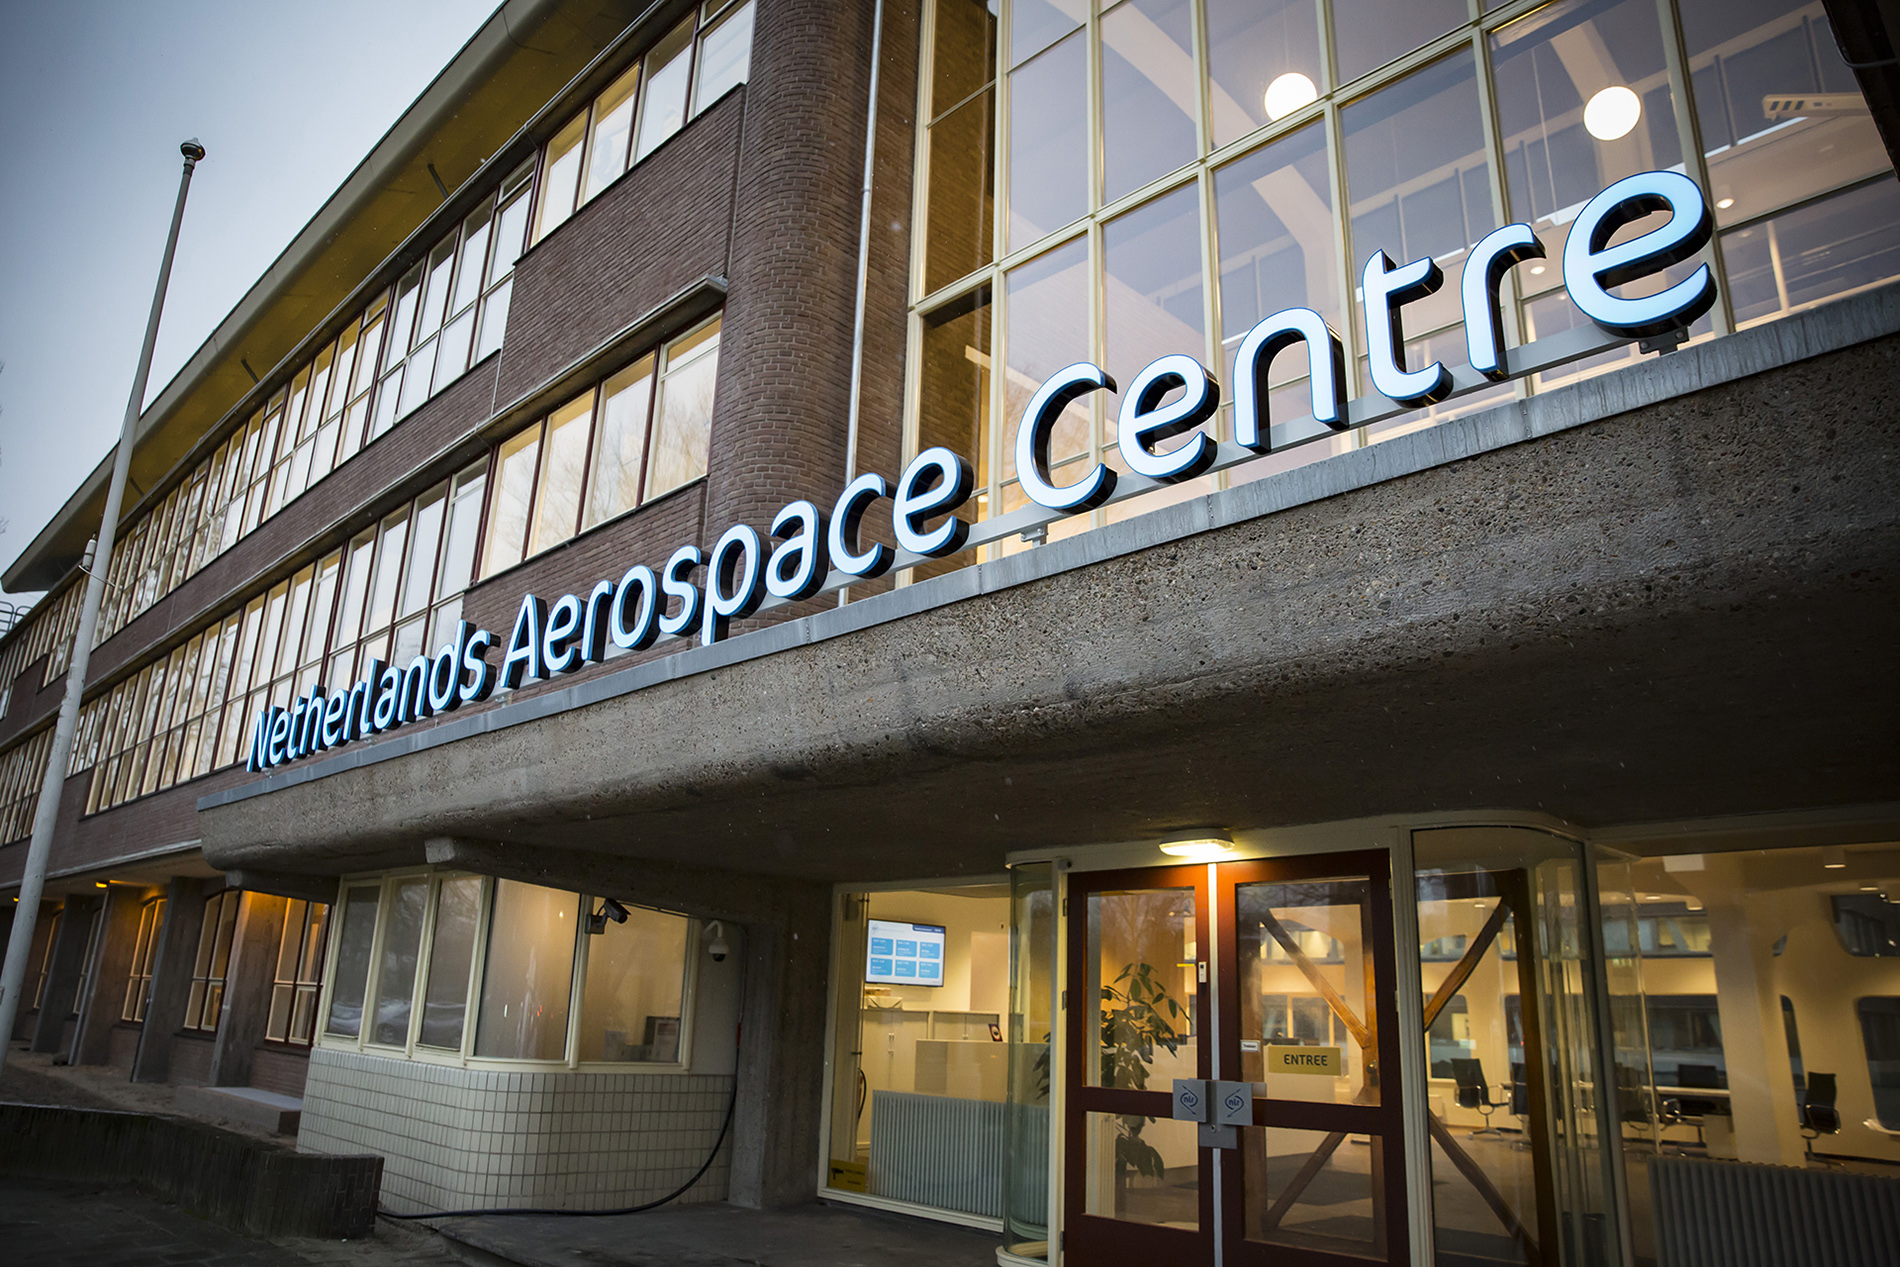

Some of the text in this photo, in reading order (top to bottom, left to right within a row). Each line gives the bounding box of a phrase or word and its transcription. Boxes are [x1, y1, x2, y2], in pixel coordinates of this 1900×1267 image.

[247, 170, 1718, 773] Netherlands Aerospace Centre
[1283, 1053, 1328, 1066] ENTREE
